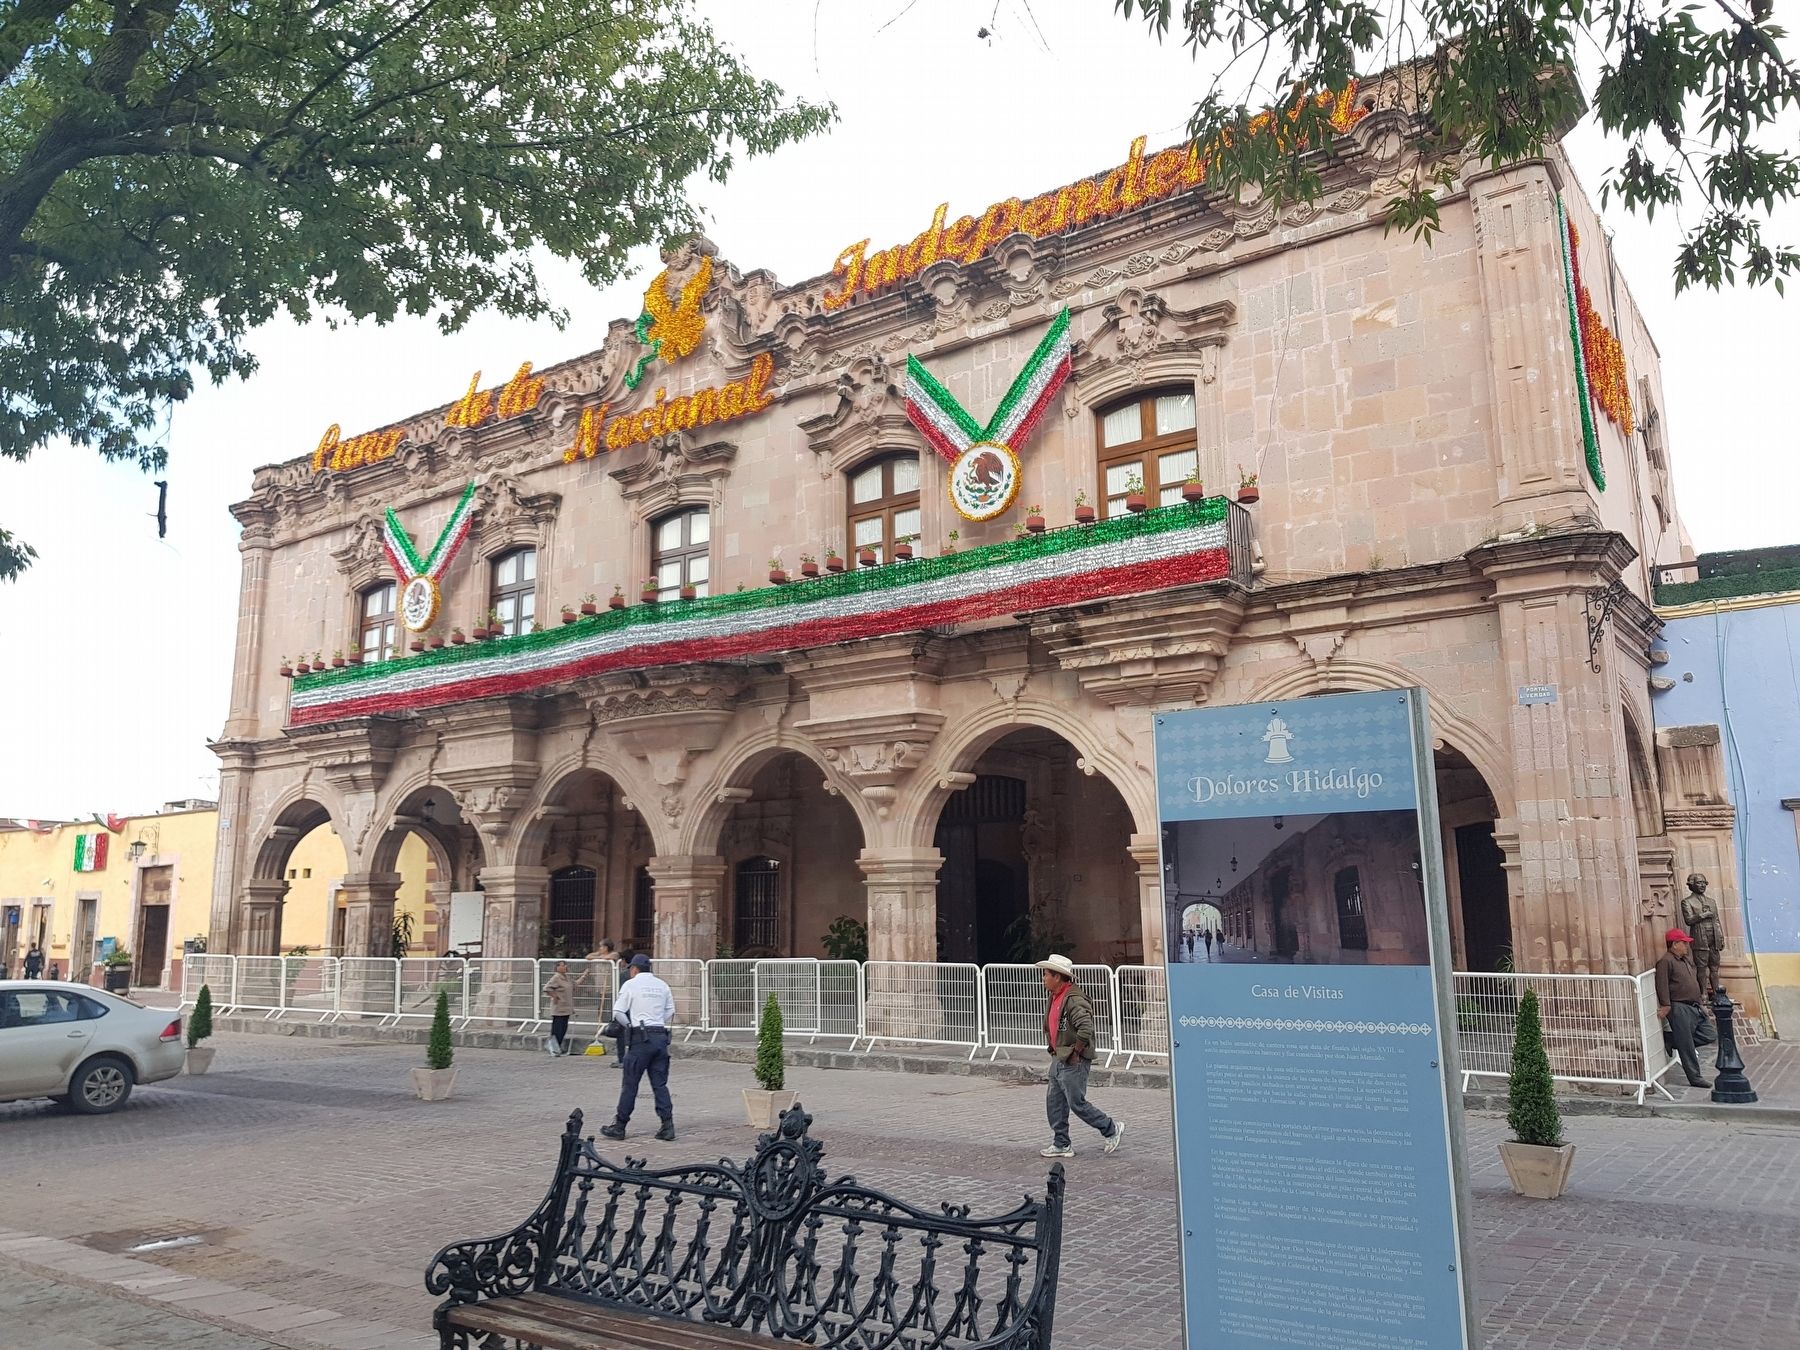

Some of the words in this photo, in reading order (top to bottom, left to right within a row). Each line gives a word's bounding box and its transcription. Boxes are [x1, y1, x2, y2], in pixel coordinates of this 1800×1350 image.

[445, 370, 493, 428] de
[497, 361, 546, 418] la
[562, 352, 774, 464] Nacional
[1187, 774, 1279, 802] Dolores
[1285, 767, 1383, 798] Hidalgo
[1251, 984, 1280, 998] Casa
[1284, 985, 1300, 998] de
[1301, 985, 1344, 999] Visitas
